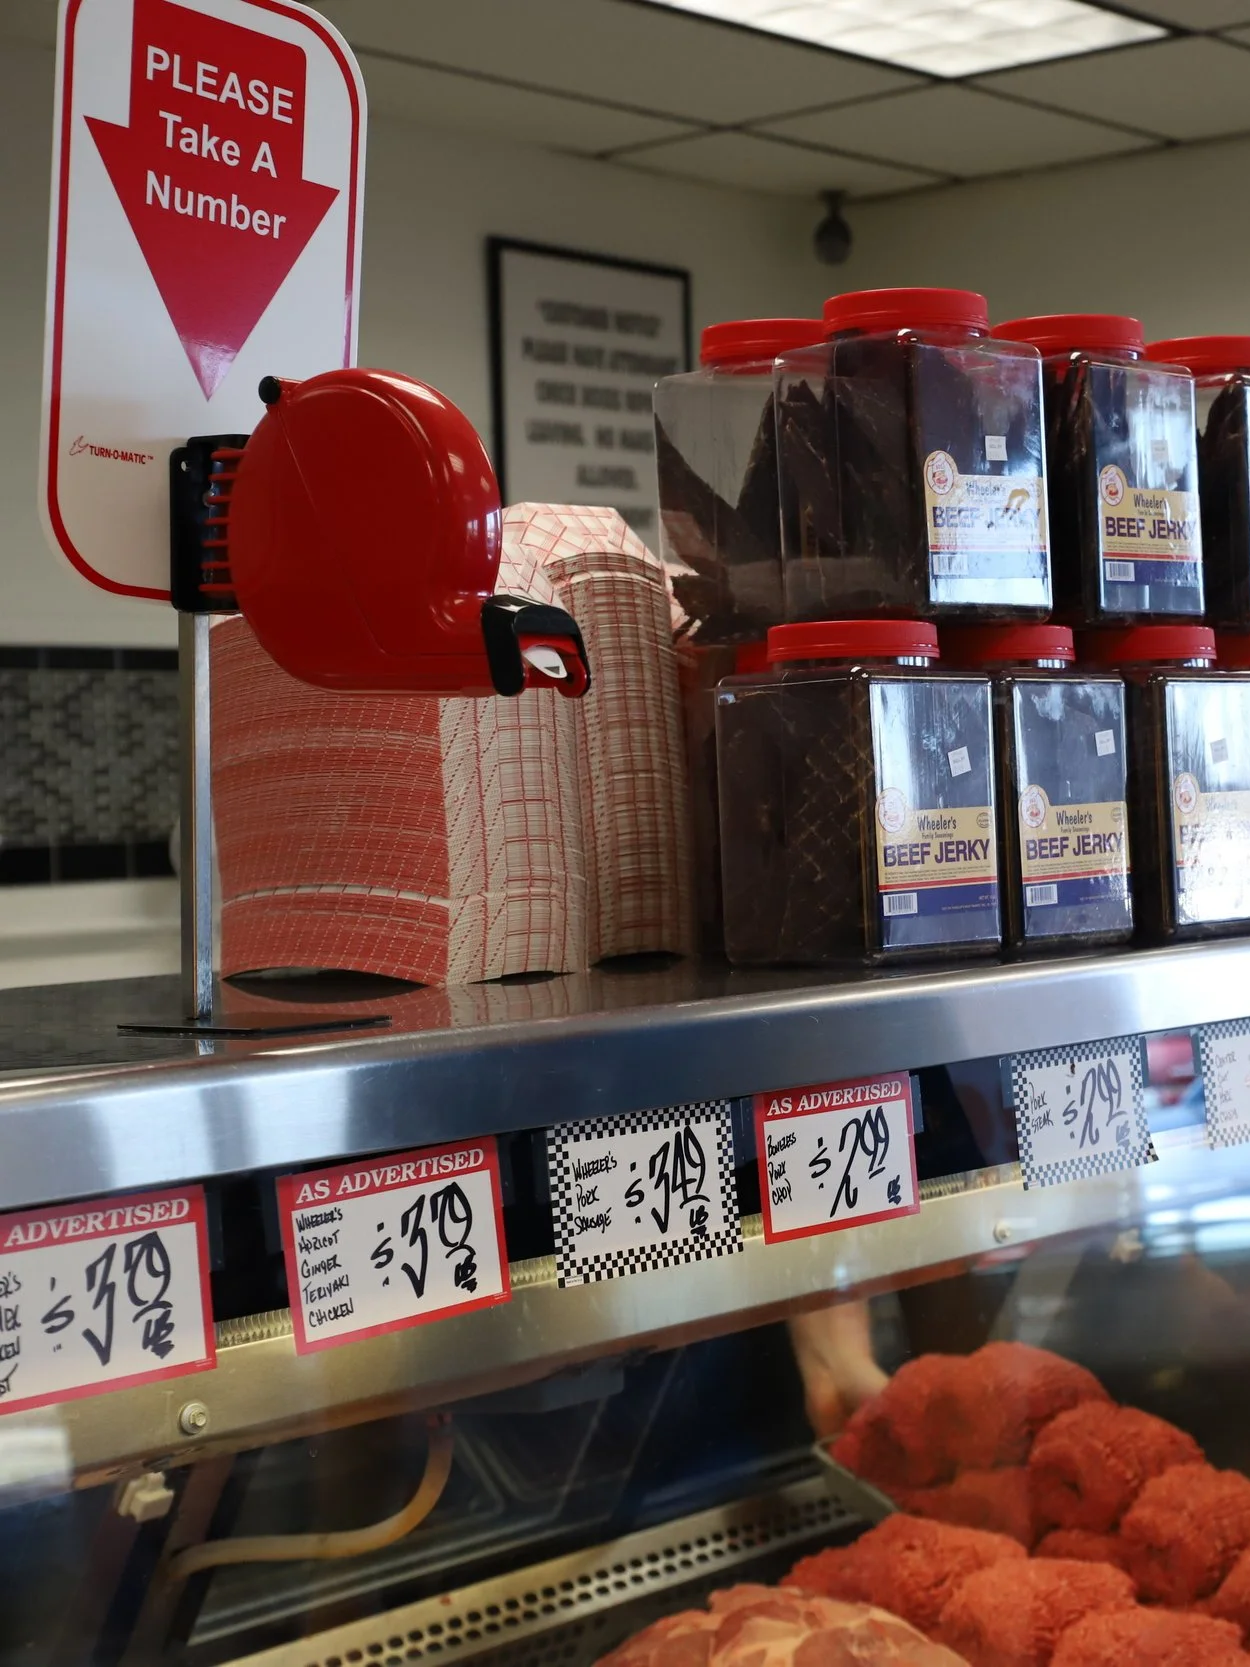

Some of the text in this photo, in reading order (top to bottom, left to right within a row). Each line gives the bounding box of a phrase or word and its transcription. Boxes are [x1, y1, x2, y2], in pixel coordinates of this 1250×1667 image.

[146, 46, 294, 124] PLEASE
[158, 111, 278, 178] Take A
[146, 170, 286, 239] Number
[89, 445, 146, 464] TURN-O-MATIC
[1105, 516, 1197, 540] BEEF JERKY
[917, 815, 957, 831] Wheeler's
[1056, 810, 1093, 826] Wheeler's
[883, 839, 990, 867] BEEF JERKY
[1026, 832, 1123, 860] BEEF JERKY
[767, 1080, 902, 1116] AS ADVERTISED
[1028, 1082, 1047, 1114] PORK
[1031, 1109, 1054, 1134] STEAK
[296, 1148, 484, 1204] AS ADVERTISED
[768, 1161, 786, 1185] PORK
[575, 1184, 600, 1212] PORK
[771, 1178, 792, 1205] CHOP
[4, 1198, 189, 1247] ADVERTISED
[298, 1229, 340, 1254] APRICOT
[301, 1254, 342, 1278] GINGER
[302, 1274, 349, 1304] TERIYAKI
[309, 1297, 354, 1327] CHICKEN
